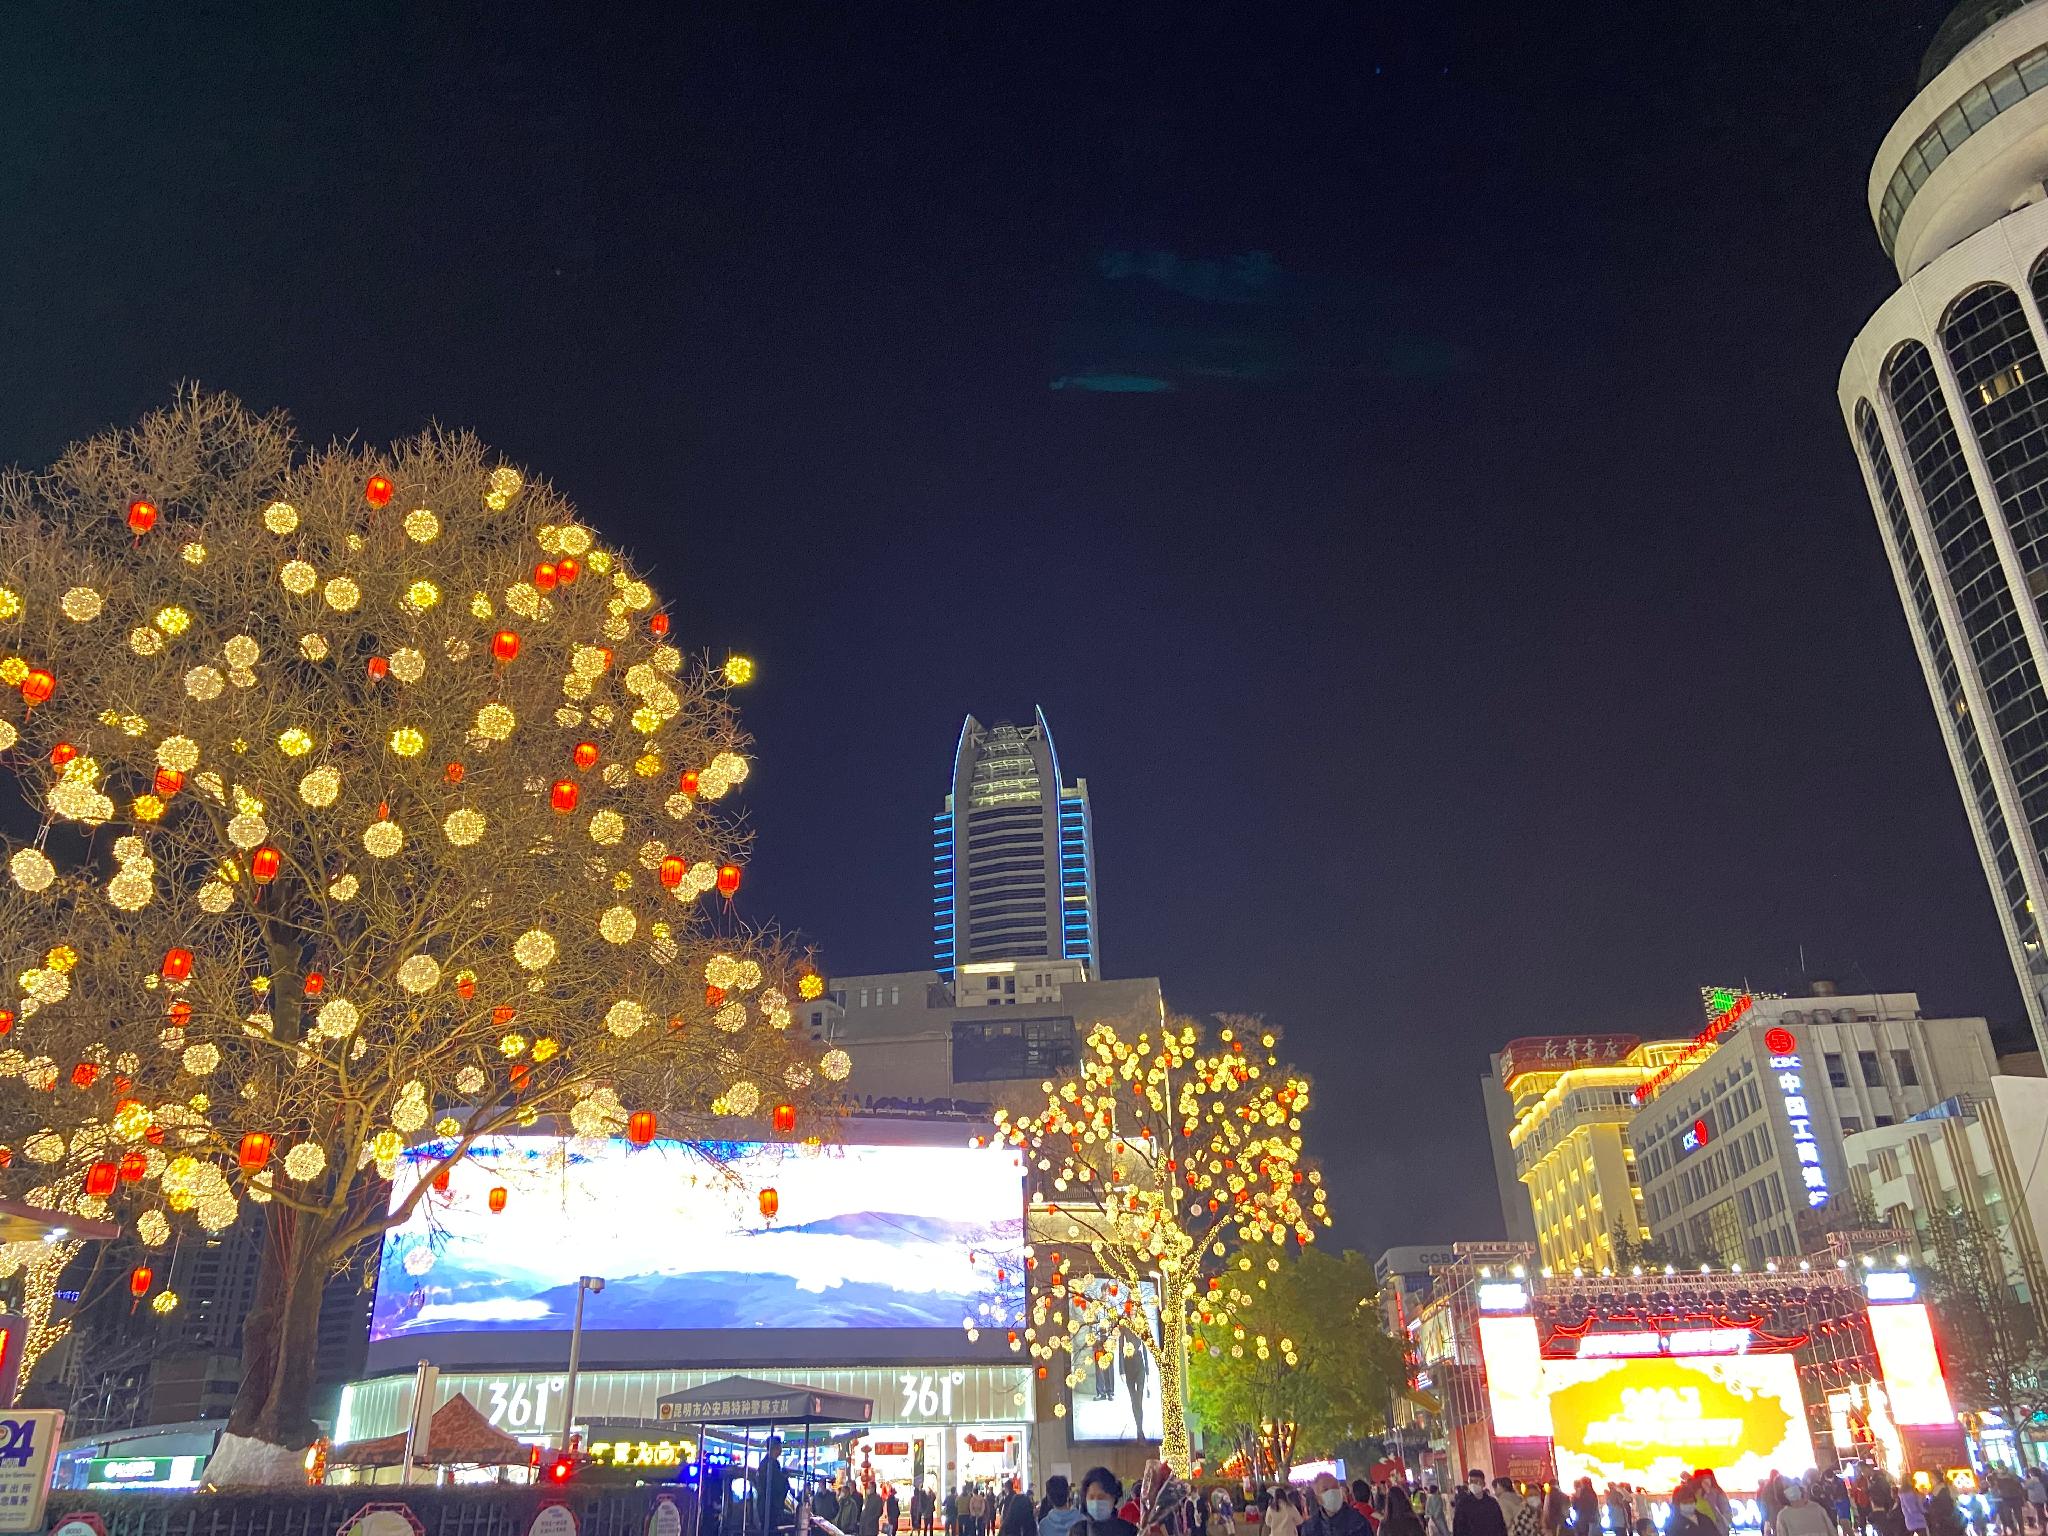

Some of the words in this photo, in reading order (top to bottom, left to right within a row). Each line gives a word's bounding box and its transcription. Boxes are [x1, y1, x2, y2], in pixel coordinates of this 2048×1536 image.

[1769, 1056, 1802, 1068] ICBC
[1778, 1072, 1829, 1207] 中国工商银行
[1419, 1253, 1451, 1264] CCB
